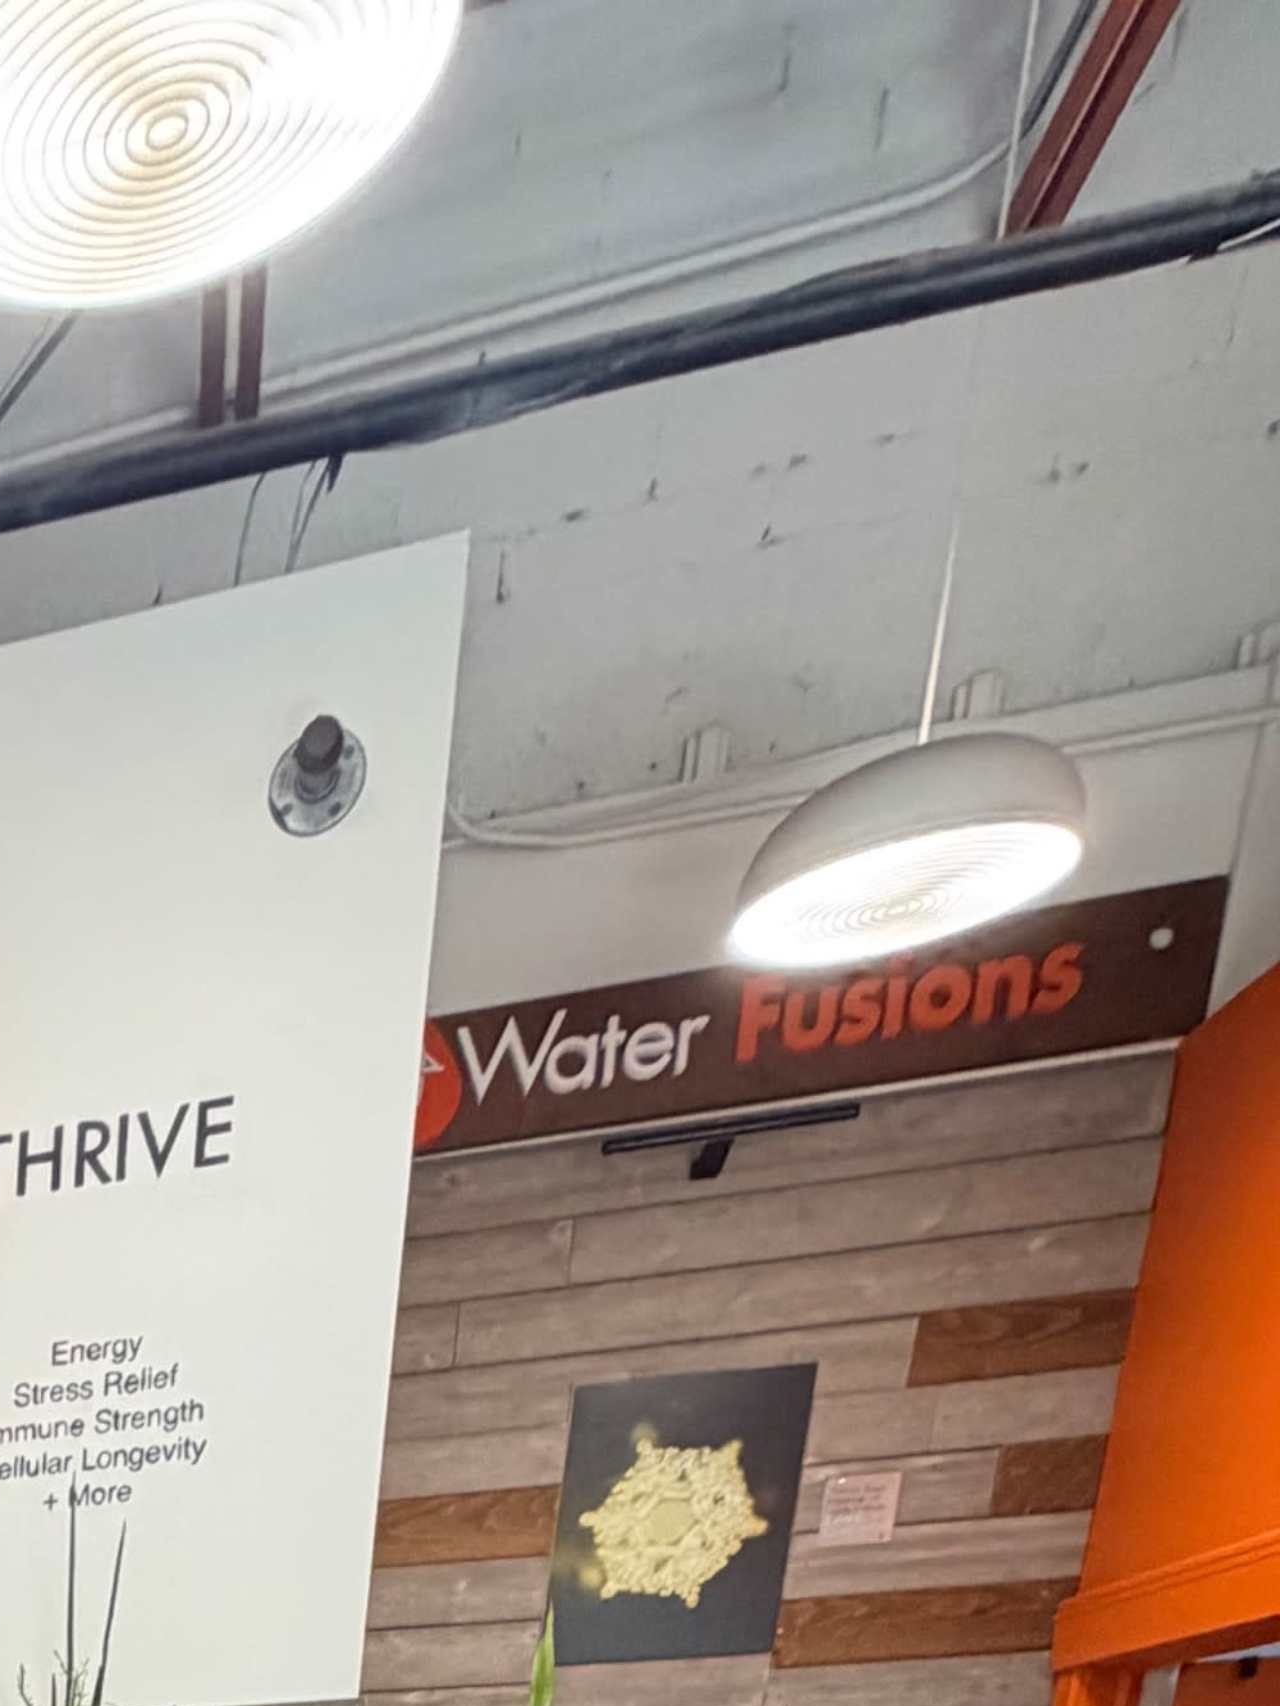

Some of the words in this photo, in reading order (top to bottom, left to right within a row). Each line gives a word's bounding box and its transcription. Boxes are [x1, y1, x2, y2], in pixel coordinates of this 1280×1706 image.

[457, 1008, 710, 1108] Water
[735, 940, 1085, 1063] Fusions
[51, 1334, 144, 1368] Energy
[13, 1377, 95, 1408] Stress
[103, 1363, 179, 1397] Relief
[94, 1398, 205, 1439] Strength
[81, 1436, 208, 1478] Longevity
[69, 1480, 132, 1508] More
